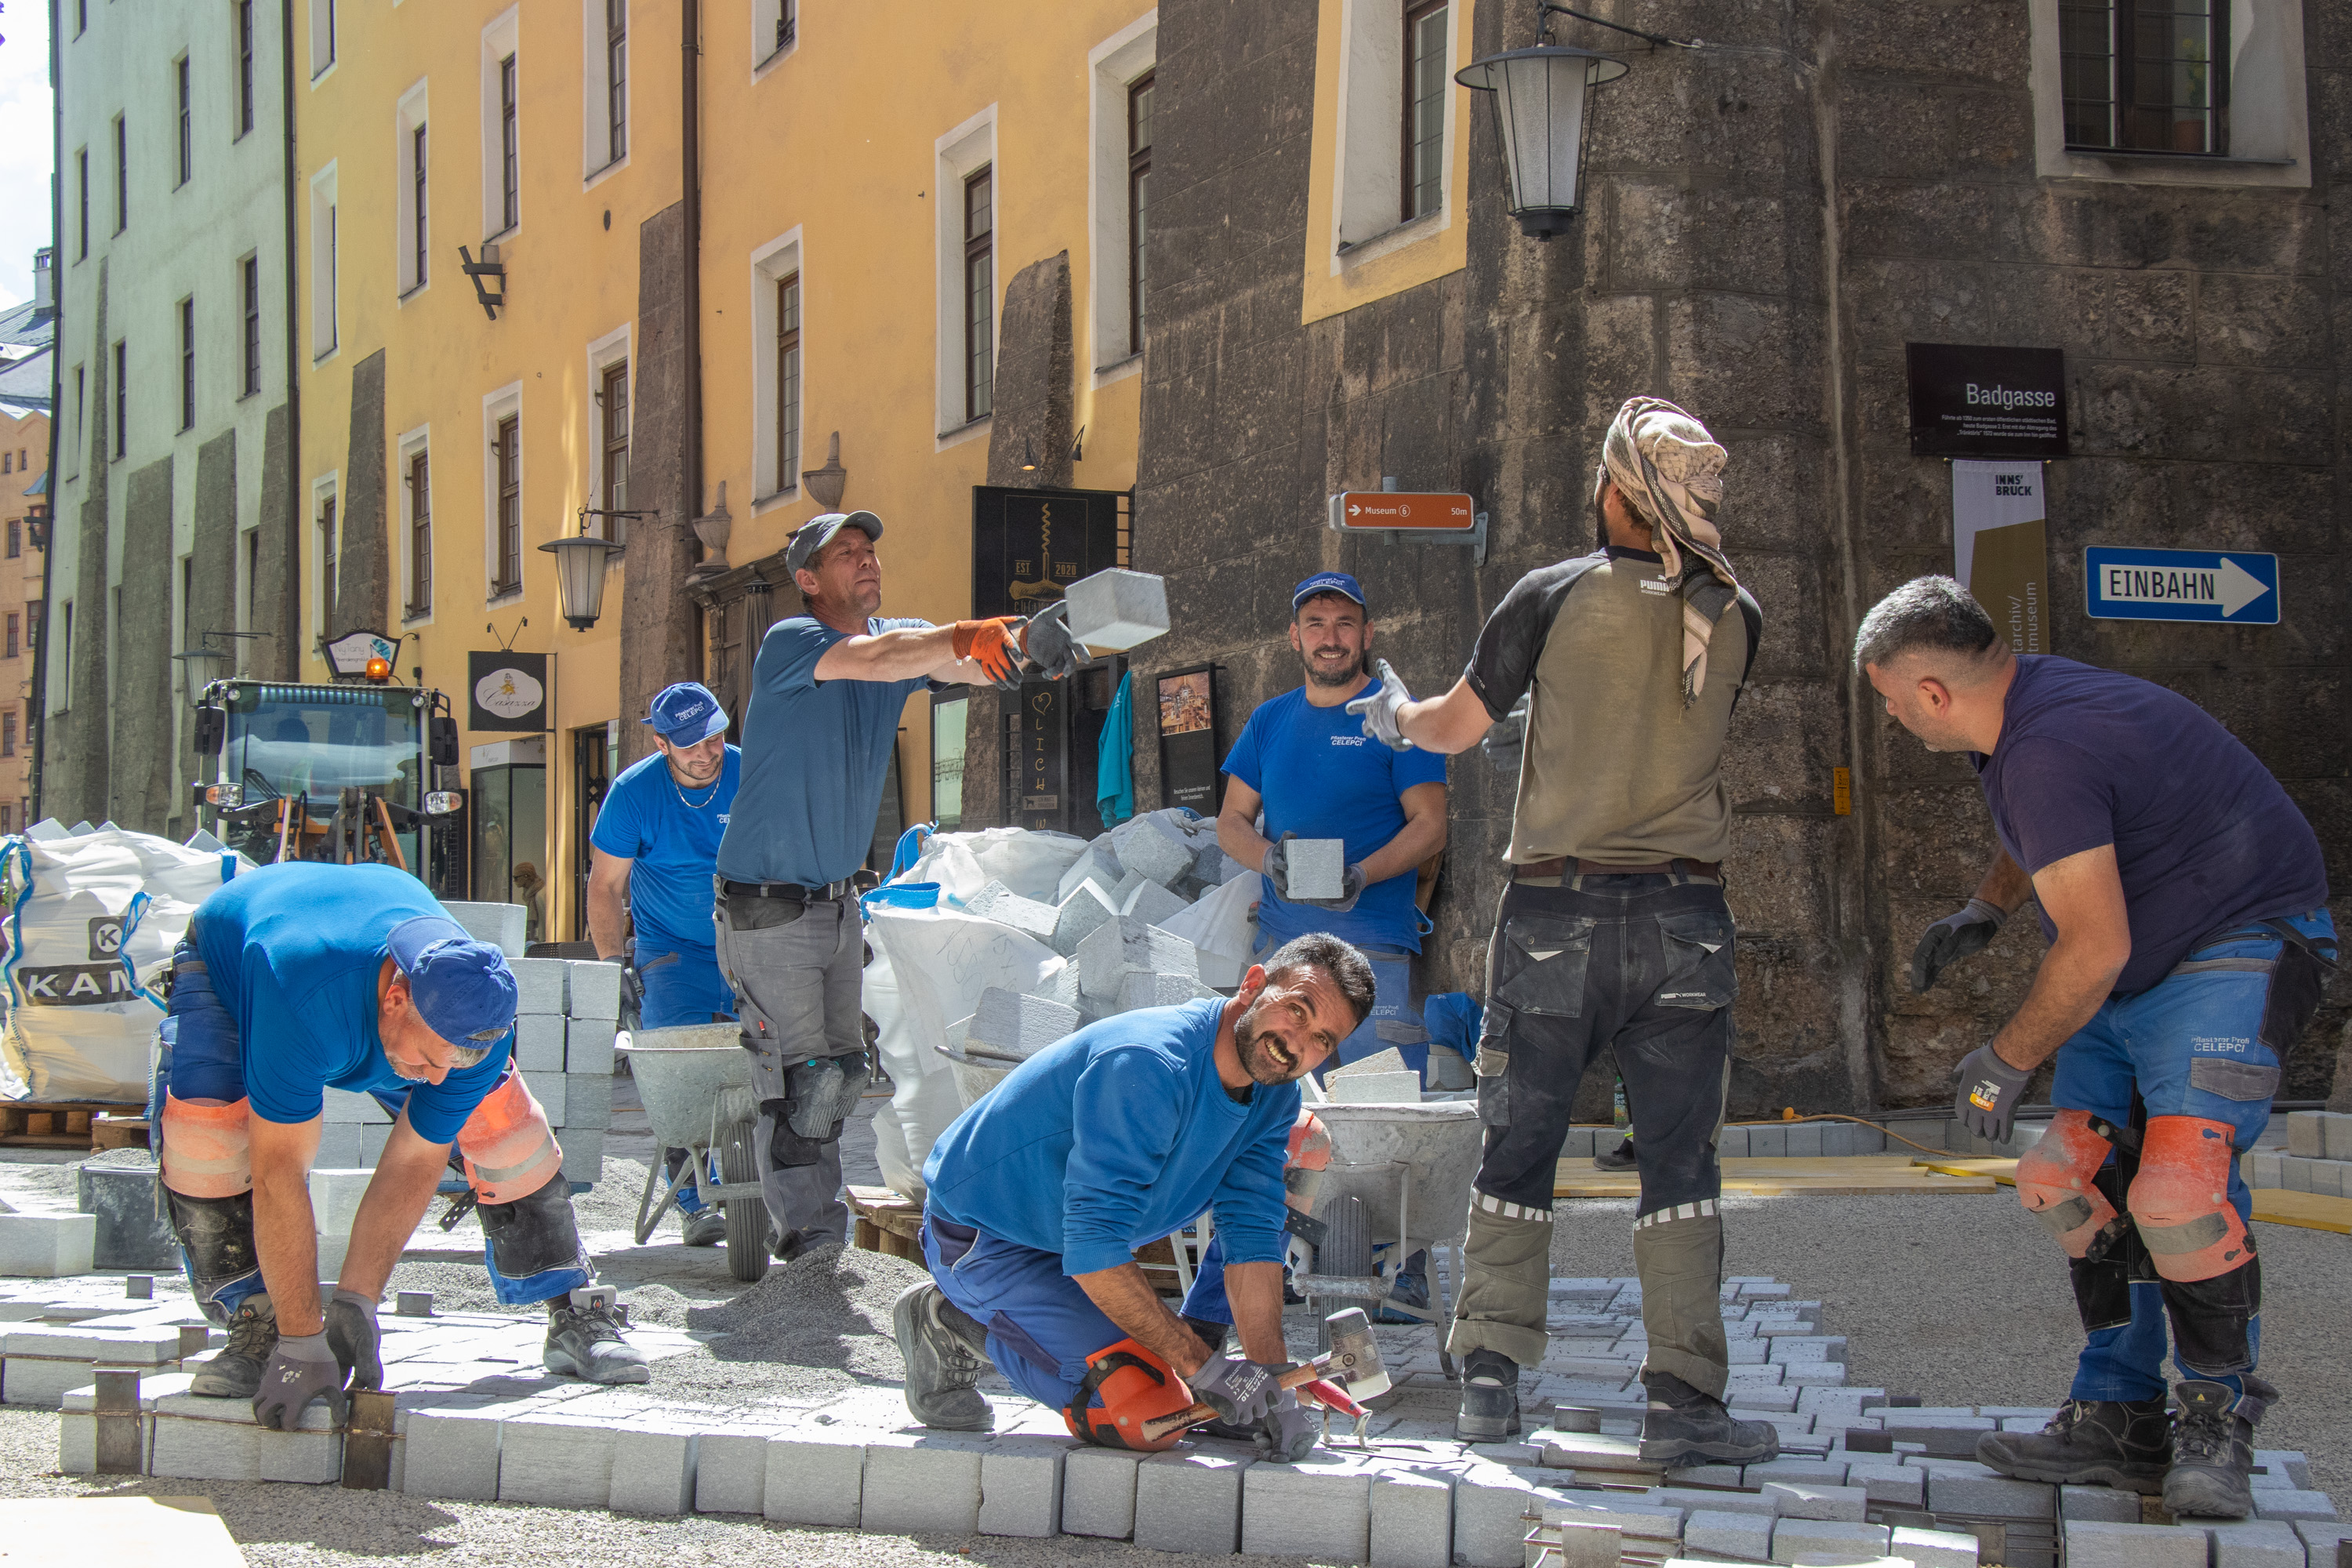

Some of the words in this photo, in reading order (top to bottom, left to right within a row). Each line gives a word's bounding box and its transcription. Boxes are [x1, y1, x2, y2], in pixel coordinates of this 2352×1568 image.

[1965, 383, 2056, 411] Badgasse
[1995, 485, 2032, 496] BRUCK
[1365, 506, 1397, 515] Museum
[1451, 507, 1468, 516] 50m
[1016, 562, 1030, 573] EST
[1055, 564, 1076, 575] 2020
[1640, 579, 1670, 592] PUMA
[2109, 568, 2215, 601] EINBAHN
[2027, 581, 2039, 653] tmuseum
[2008, 595, 2024, 653] tarchiv/
[483, 688, 535, 707] Casazza
[679, 706, 705, 721] CELEPCI
[99, 928, 120, 947] K
[2231, 1036, 2250, 1044] Profi
[2194, 1043, 2245, 1053] CELEPCI
[1241, 1393, 1250, 1402] 10
